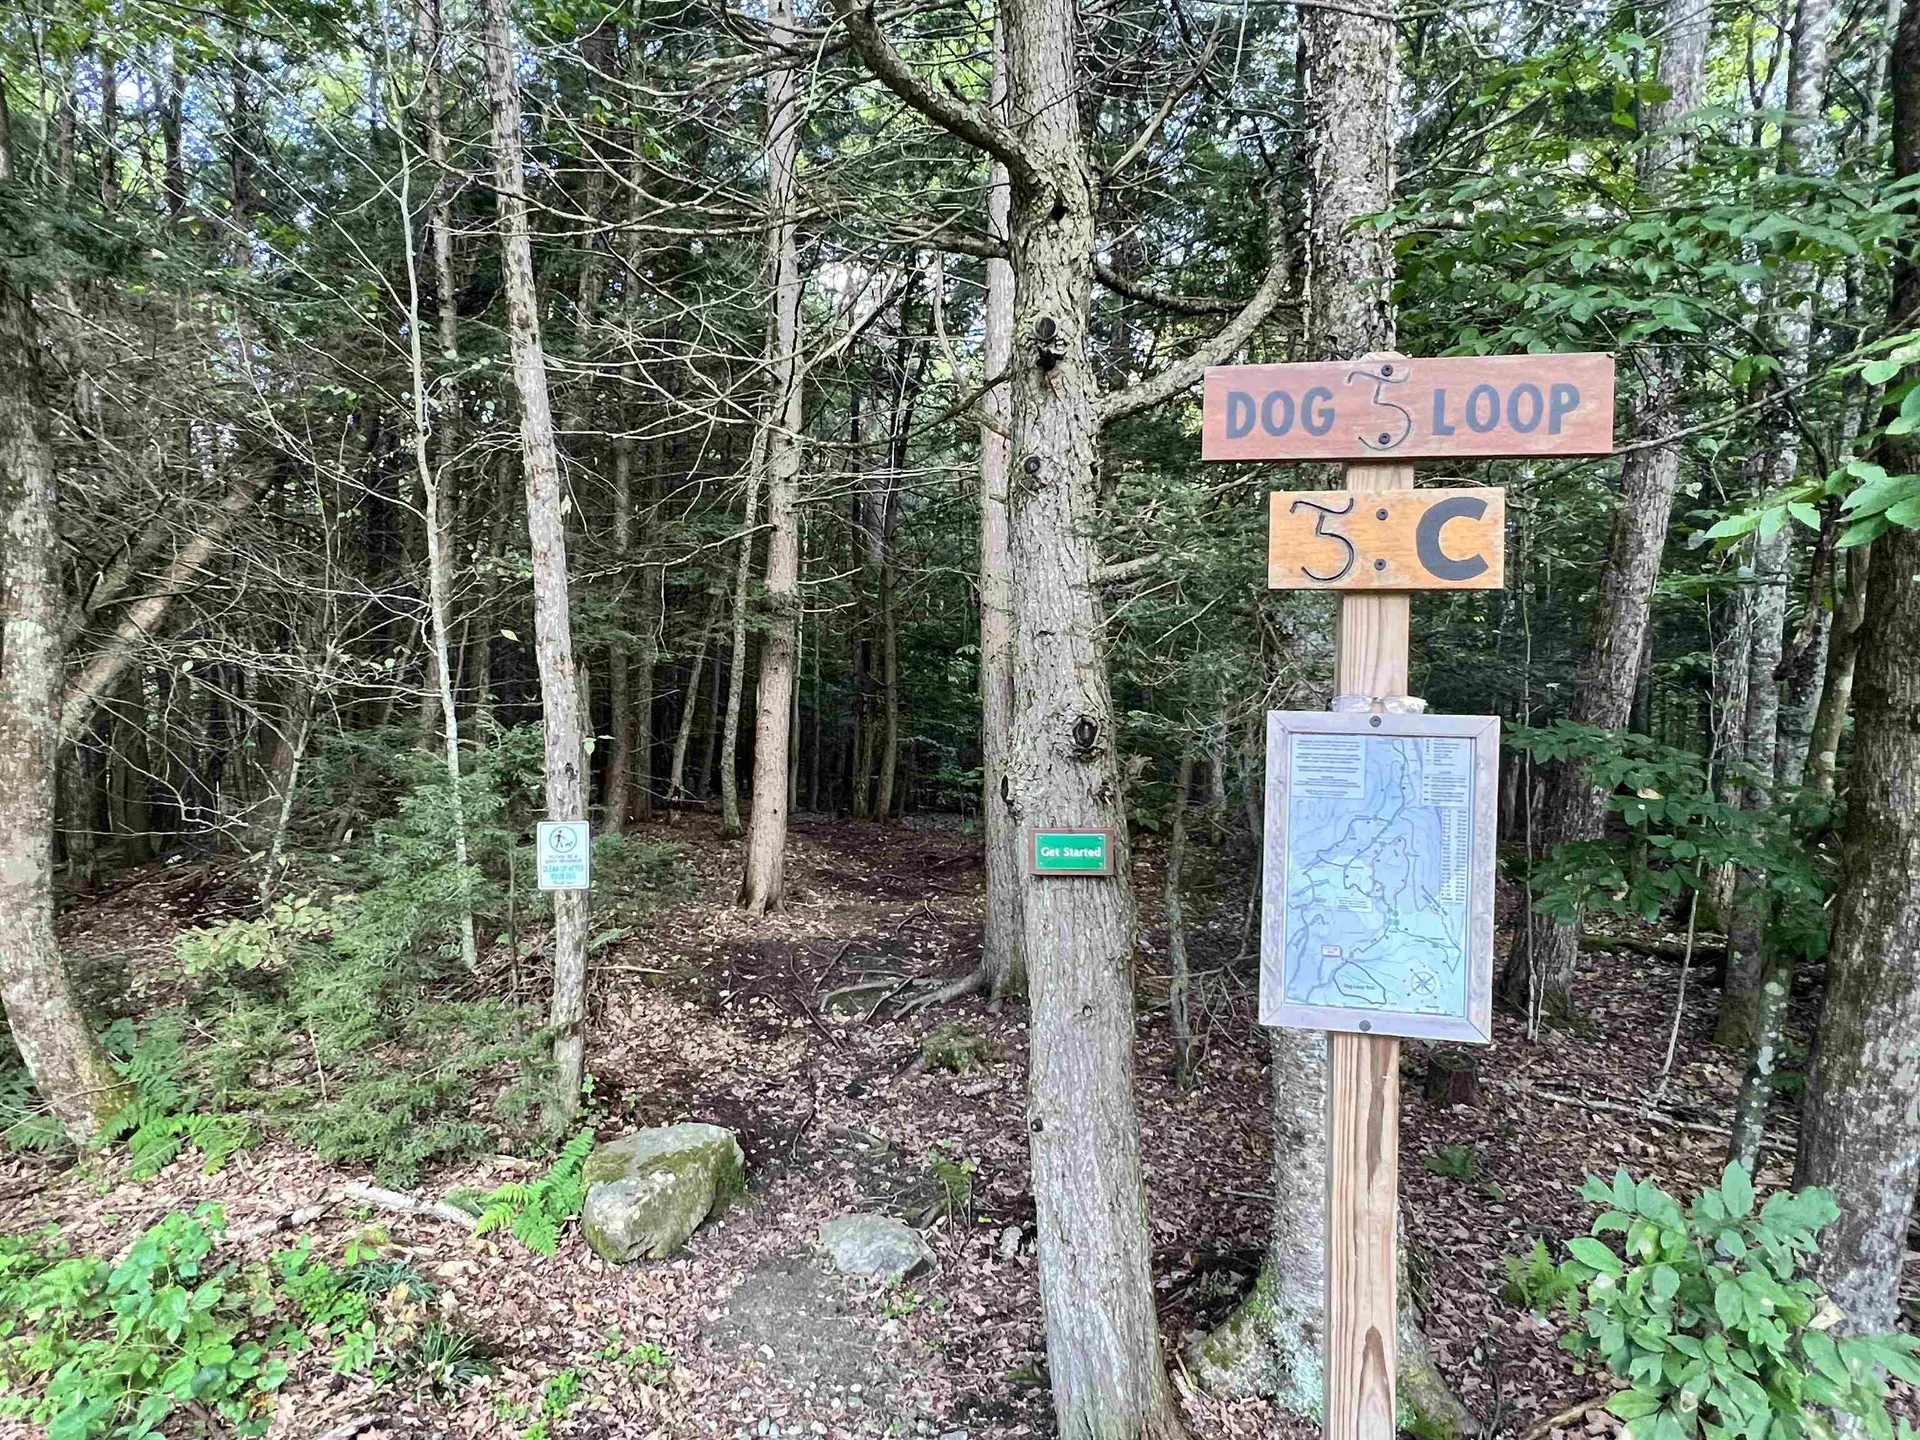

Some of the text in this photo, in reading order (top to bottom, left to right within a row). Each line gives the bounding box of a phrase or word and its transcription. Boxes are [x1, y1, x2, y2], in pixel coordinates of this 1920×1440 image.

[1225, 386, 1335, 439] DOG
[1432, 382, 1580, 436] LOOP
[1415, 496, 1490, 581] C
[1041, 846, 1102, 857] Get Started
